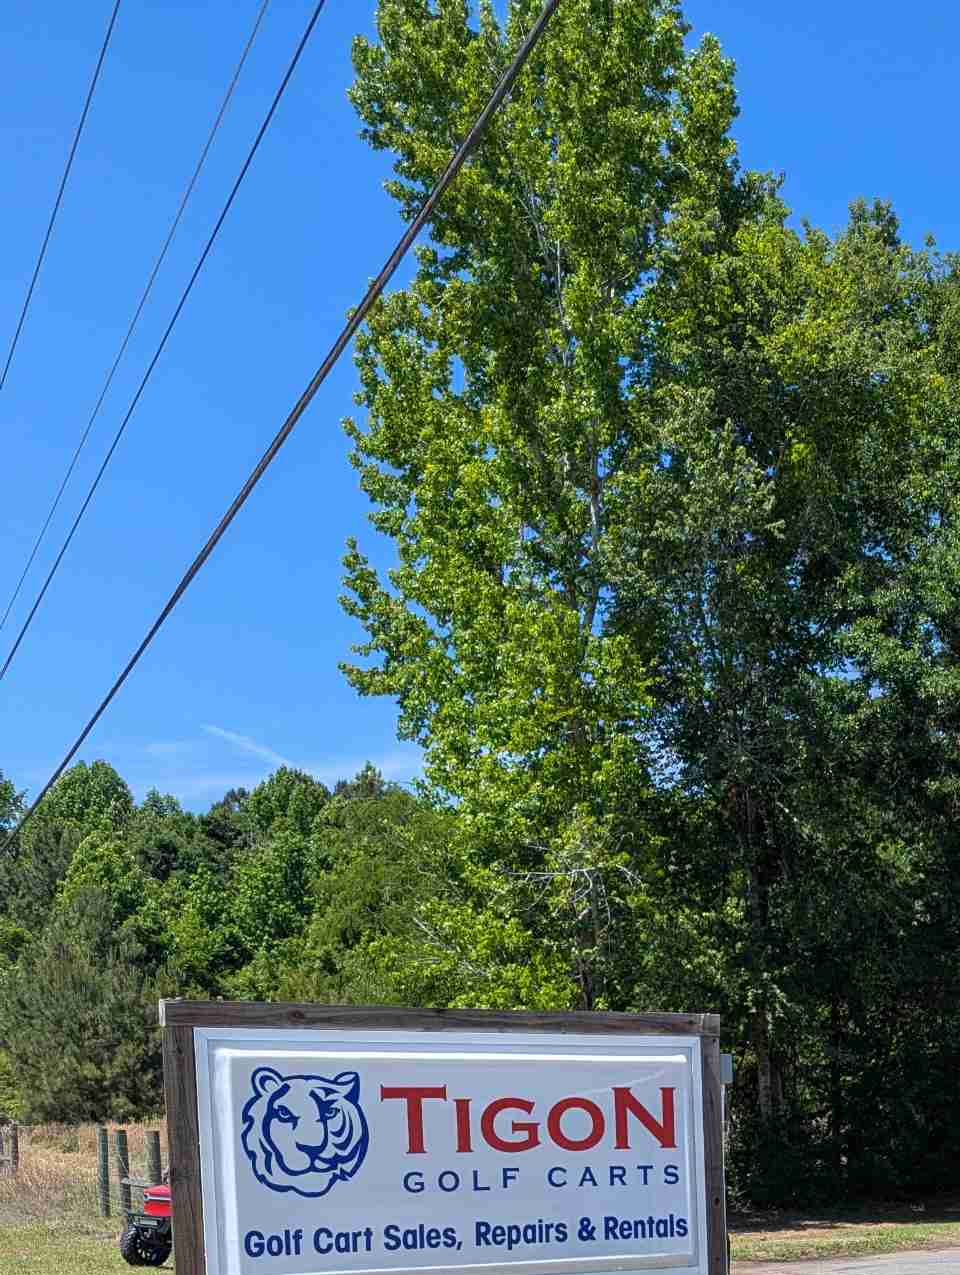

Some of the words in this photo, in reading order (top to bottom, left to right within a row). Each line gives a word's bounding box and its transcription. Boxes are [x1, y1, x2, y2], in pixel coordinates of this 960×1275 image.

[403, 1167, 520, 1194] GOLF
[547, 1164, 681, 1188] CARTS
[244, 1228, 303, 1258] Golf
[313, 1226, 374, 1255] Cart
[383, 1223, 463, 1252] Sales,
[475, 1219, 569, 1251] Repairs
[577, 1216, 597, 1242] &
[603, 1213, 689, 1242] Rentals
